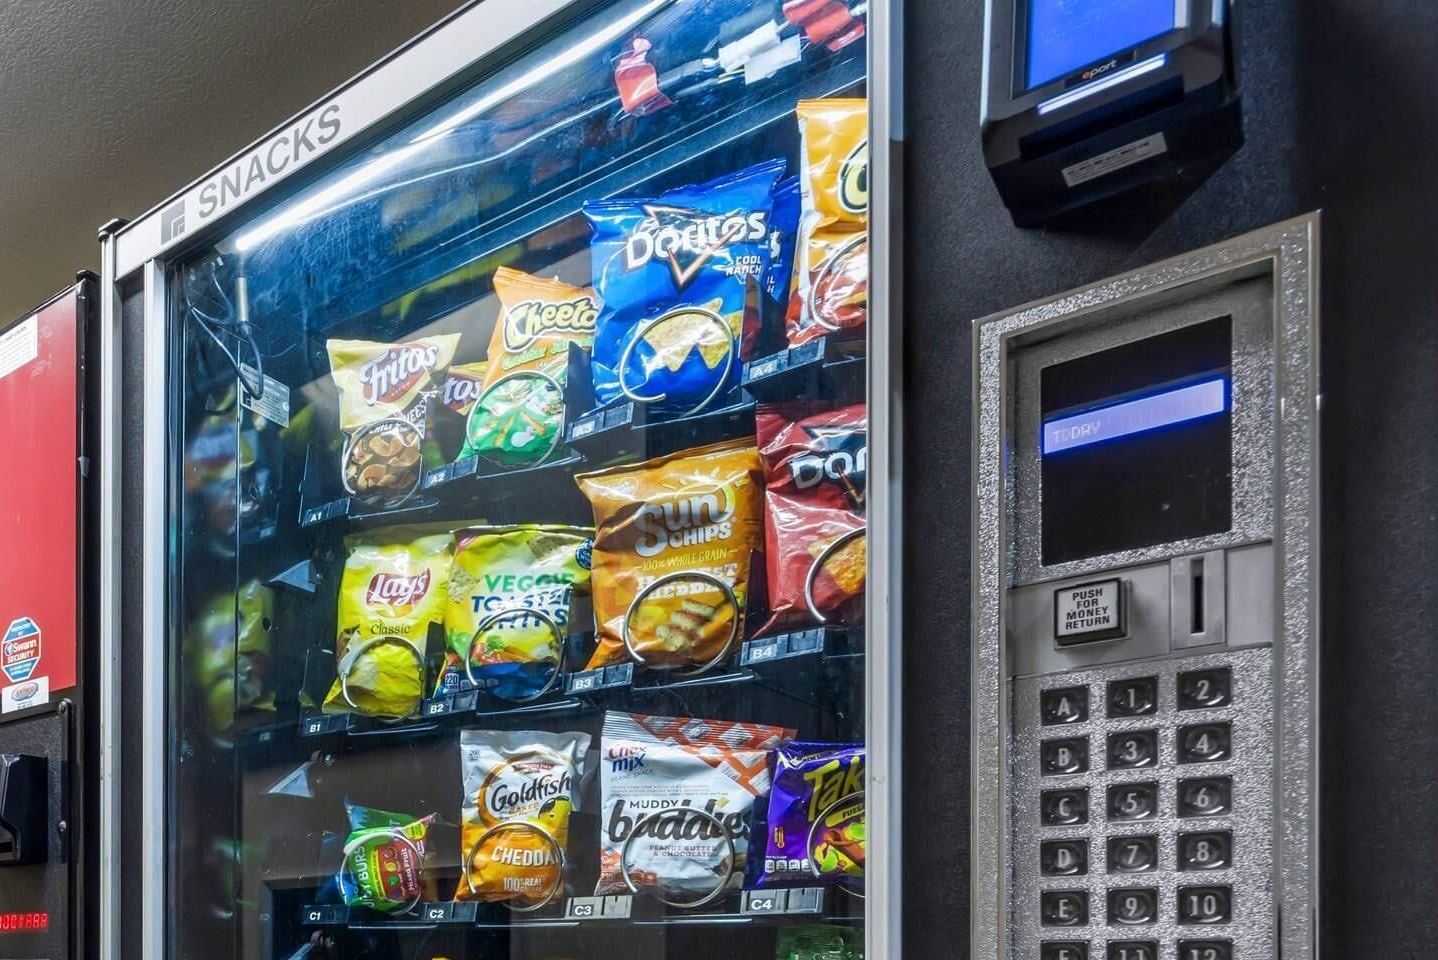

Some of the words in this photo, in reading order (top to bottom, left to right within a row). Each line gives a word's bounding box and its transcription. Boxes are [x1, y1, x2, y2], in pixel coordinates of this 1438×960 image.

[198, 104, 341, 219] SNACKS
[626, 210, 767, 272] Doritos
[735, 255, 762, 266] COOL
[725, 265, 762, 278] RANCH
[506, 297, 599, 351] Cheeto
[360, 346, 439, 406] Fritos
[431, 472, 444, 483] A2
[634, 486, 736, 558] Sun
[668, 521, 733, 549] CHIPS
[667, 552, 698, 568] WHOLE
[699, 547, 727, 563] GRAIN
[368, 573, 429, 607] Lay's
[1071, 588, 1104, 601] PUSH
[1066, 606, 1109, 621] MONEY
[1076, 598, 1100, 610] FOR
[370, 619, 411, 635] Classic
[1065, 616, 1110, 630] RETURN
[12, 639, 38, 654] Swann
[752, 645, 773, 658] B4
[7, 650, 35, 664] SECURITY
[575, 678, 592, 690] B3
[1196, 679, 1210, 701] 2
[1057, 697, 1071, 716] A
[1127, 688, 1136, 708] 1
[430, 704, 444, 714] B2
[309, 722, 321, 732] B1
[1125, 740, 1138, 761] 3
[1195, 733, 1210, 754] 4
[612, 753, 646, 772] mix
[1058, 747, 1069, 767] B
[491, 770, 571, 812] Goldfish
[1196, 787, 1210, 808] 6
[629, 799, 680, 809] MUDDY
[1058, 797, 1070, 817] C
[1125, 792, 1138, 812] 5
[1057, 849, 1071, 868] D
[1126, 845, 1139, 865] 7
[1196, 841, 1210, 862] 8
[429, 908, 444, 919] C2
[574, 903, 592, 916] C3
[751, 899, 773, 911] C4
[1058, 898, 1069, 918] E
[1125, 897, 1138, 917] 9
[1190, 895, 1217, 917] 10
[309, 911, 321, 921] C1
